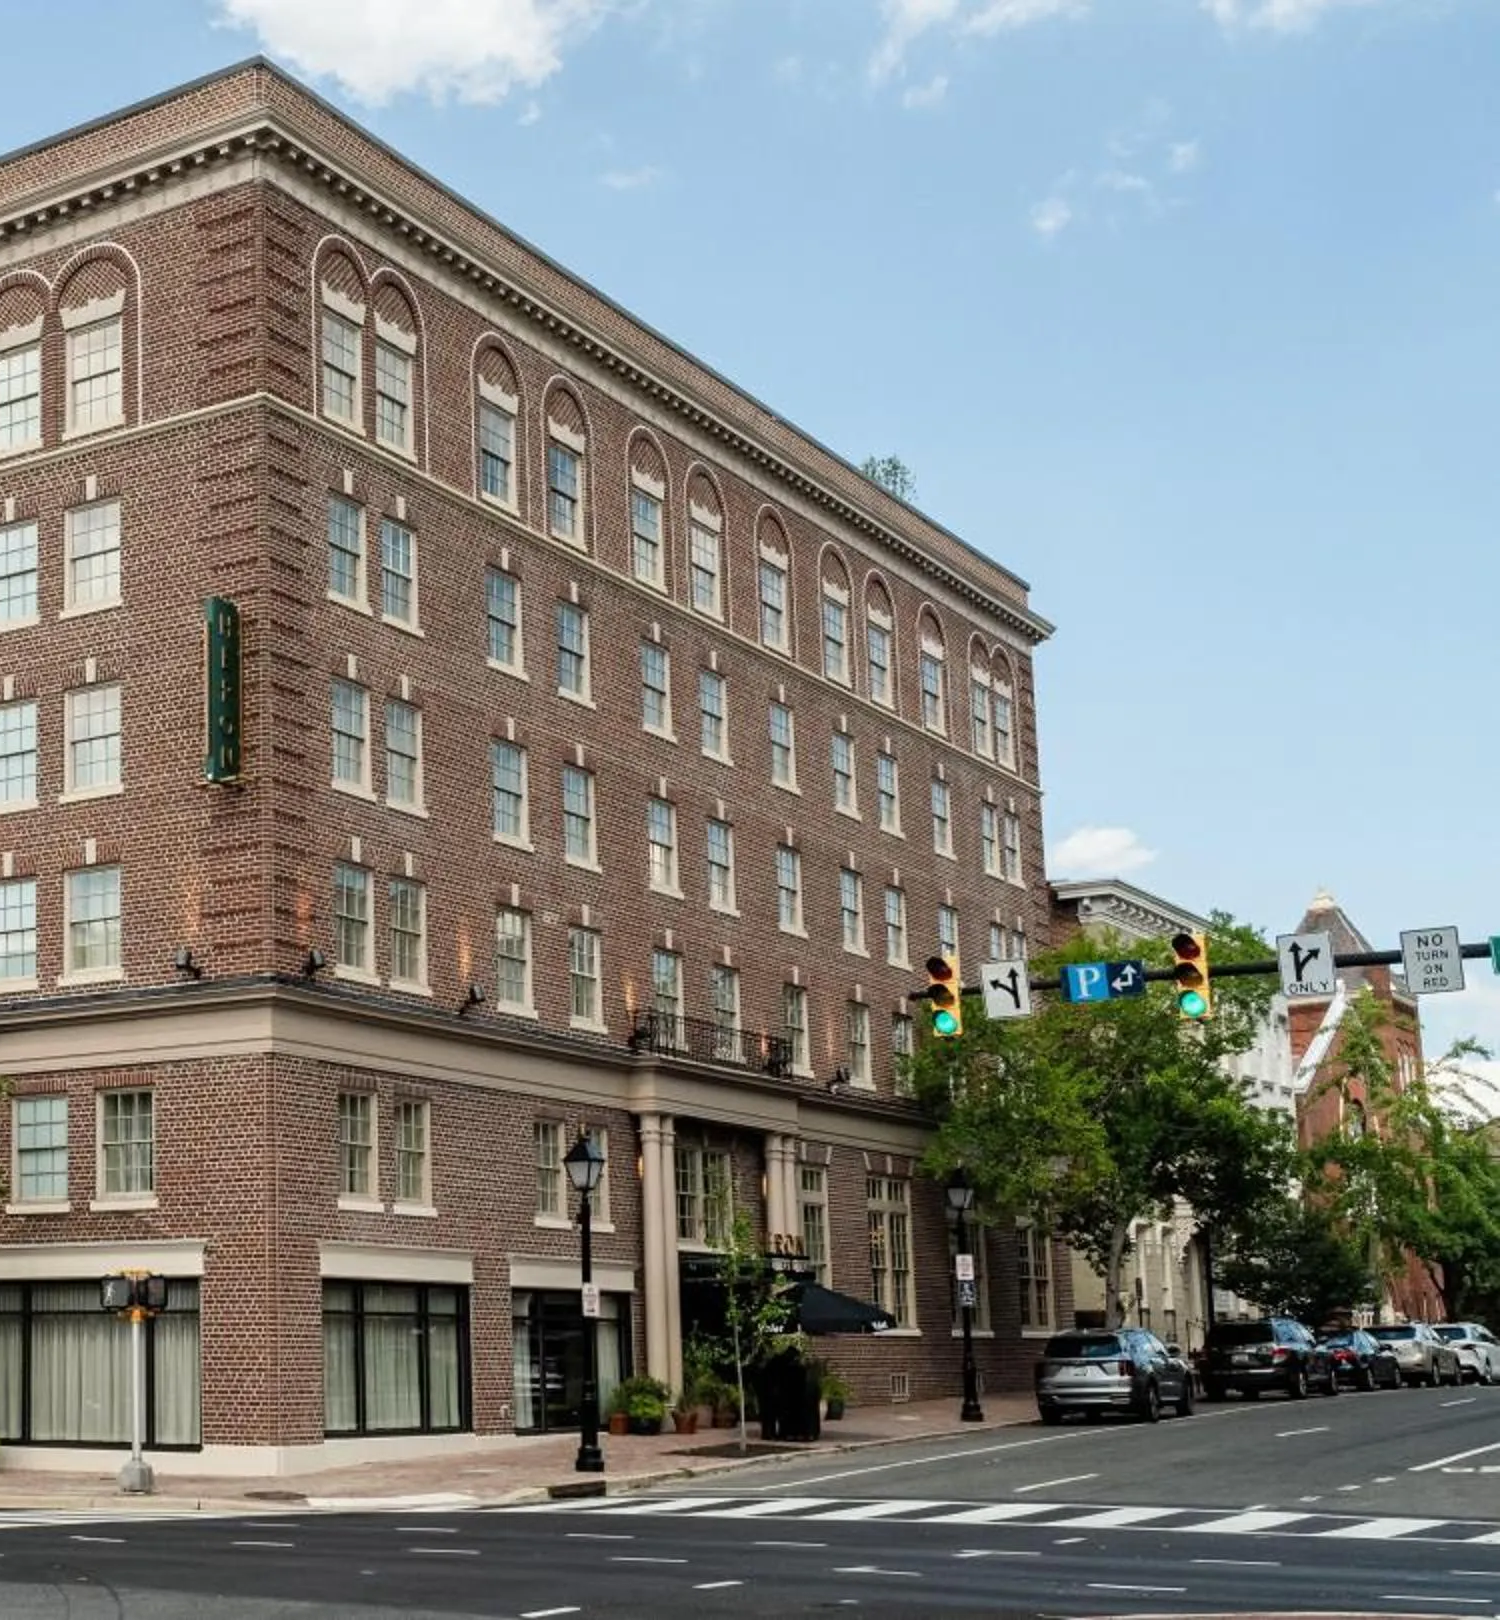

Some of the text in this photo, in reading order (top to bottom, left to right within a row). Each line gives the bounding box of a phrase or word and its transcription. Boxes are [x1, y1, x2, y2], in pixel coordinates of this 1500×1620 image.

[1417, 933, 1443, 948] NO
[1415, 950, 1449, 962] TURN
[1424, 964, 1443, 975] ON
[1076, 966, 1100, 999] P
[1289, 980, 1329, 995] ONLY
[1423, 977, 1449, 989] RED
